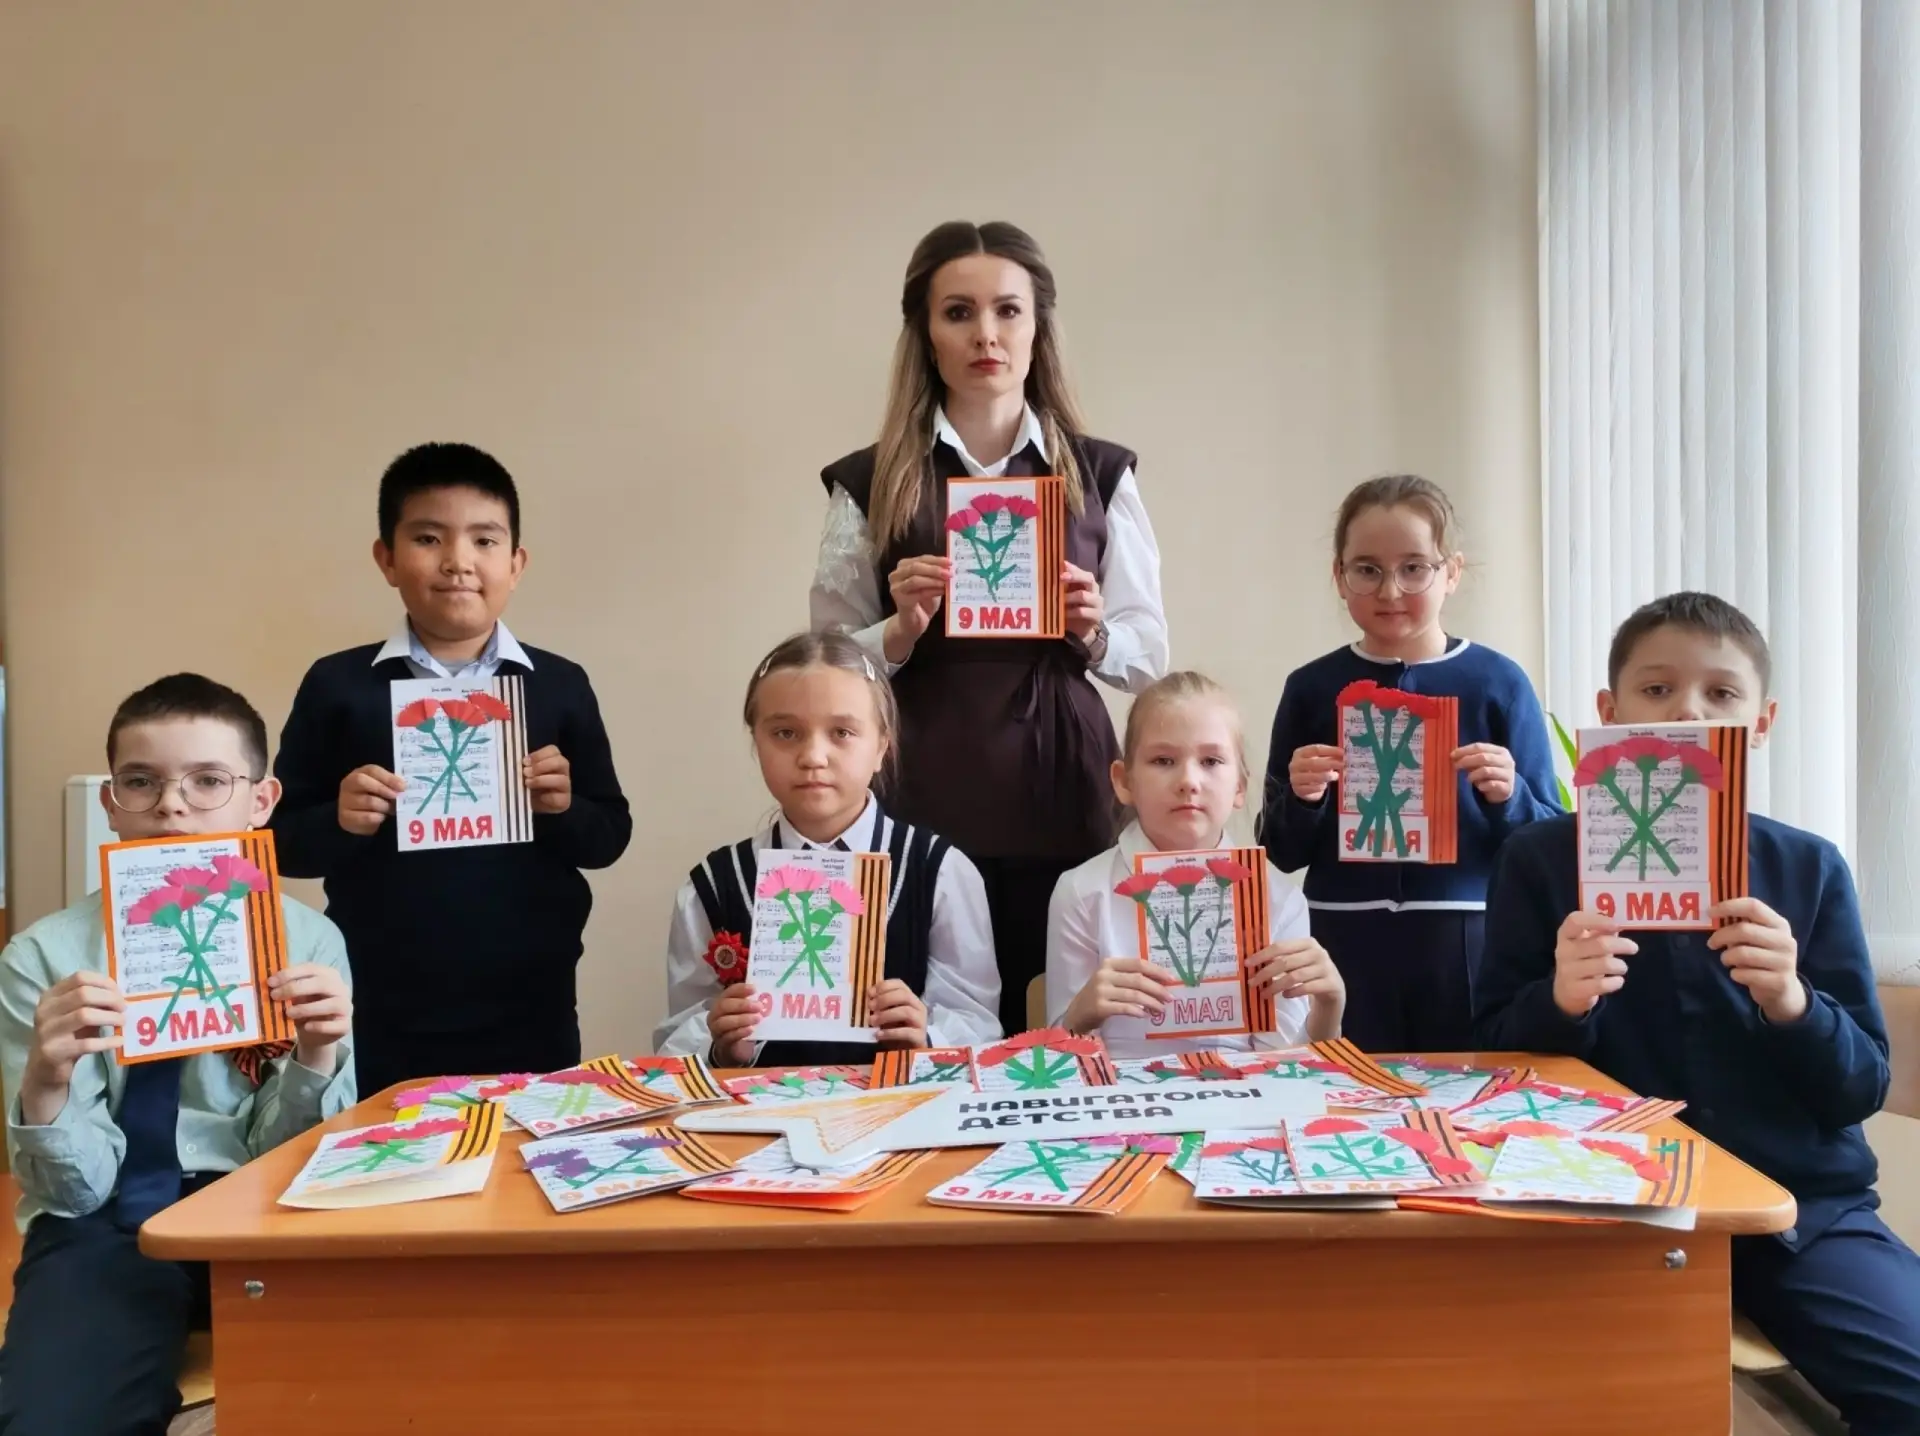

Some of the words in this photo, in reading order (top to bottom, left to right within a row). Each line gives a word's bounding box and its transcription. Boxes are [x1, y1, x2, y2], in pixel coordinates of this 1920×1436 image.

[958, 607, 974, 629] 9
[979, 606, 1032, 630] МАЯ
[409, 819, 425, 844] 9
[433, 815, 493, 842] МАЯ
[1596, 892, 1616, 918] 9
[1626, 892, 1700, 921] МАЯ
[757, 992, 773, 1018] 9
[781, 992, 842, 1020] МАЯ
[1174, 995, 1234, 1025] МАЯ
[136, 1016, 157, 1047] 9
[168, 1003, 246, 1043] МАЯ
[958, 1087, 1263, 1113] НАВИГАТОРЫ
[534, 1120, 557, 1131] 9
[564, 1106, 637, 1126] МАЯ
[957, 1106, 1174, 1131] ДЕТСТВА
[944, 1186, 970, 1197] 9
[976, 1189, 1066, 1202] МАЯ
